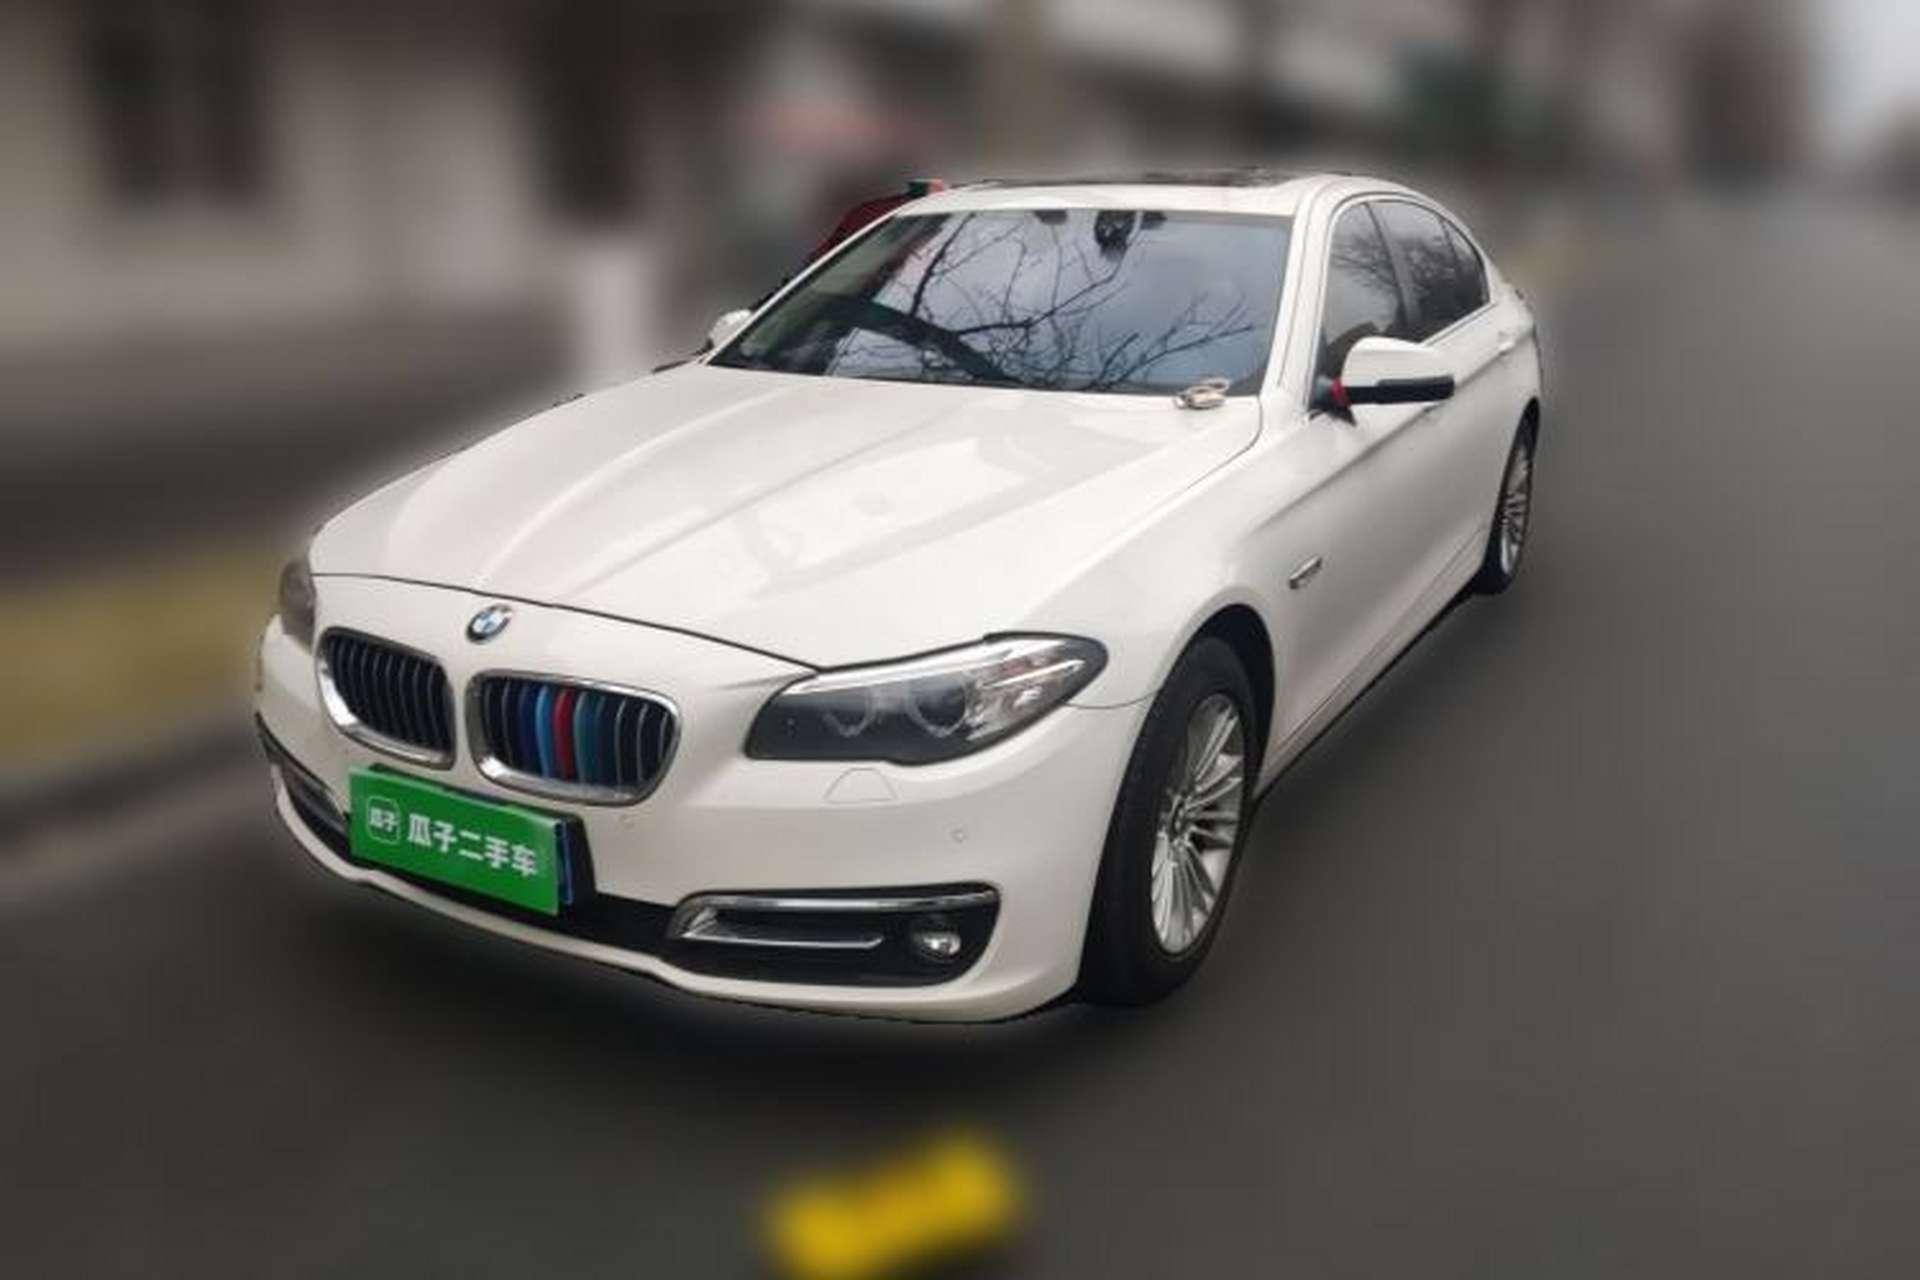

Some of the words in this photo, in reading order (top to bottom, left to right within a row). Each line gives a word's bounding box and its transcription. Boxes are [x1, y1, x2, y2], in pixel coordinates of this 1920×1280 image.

[408, 813, 537, 877] 瓜子二手车
